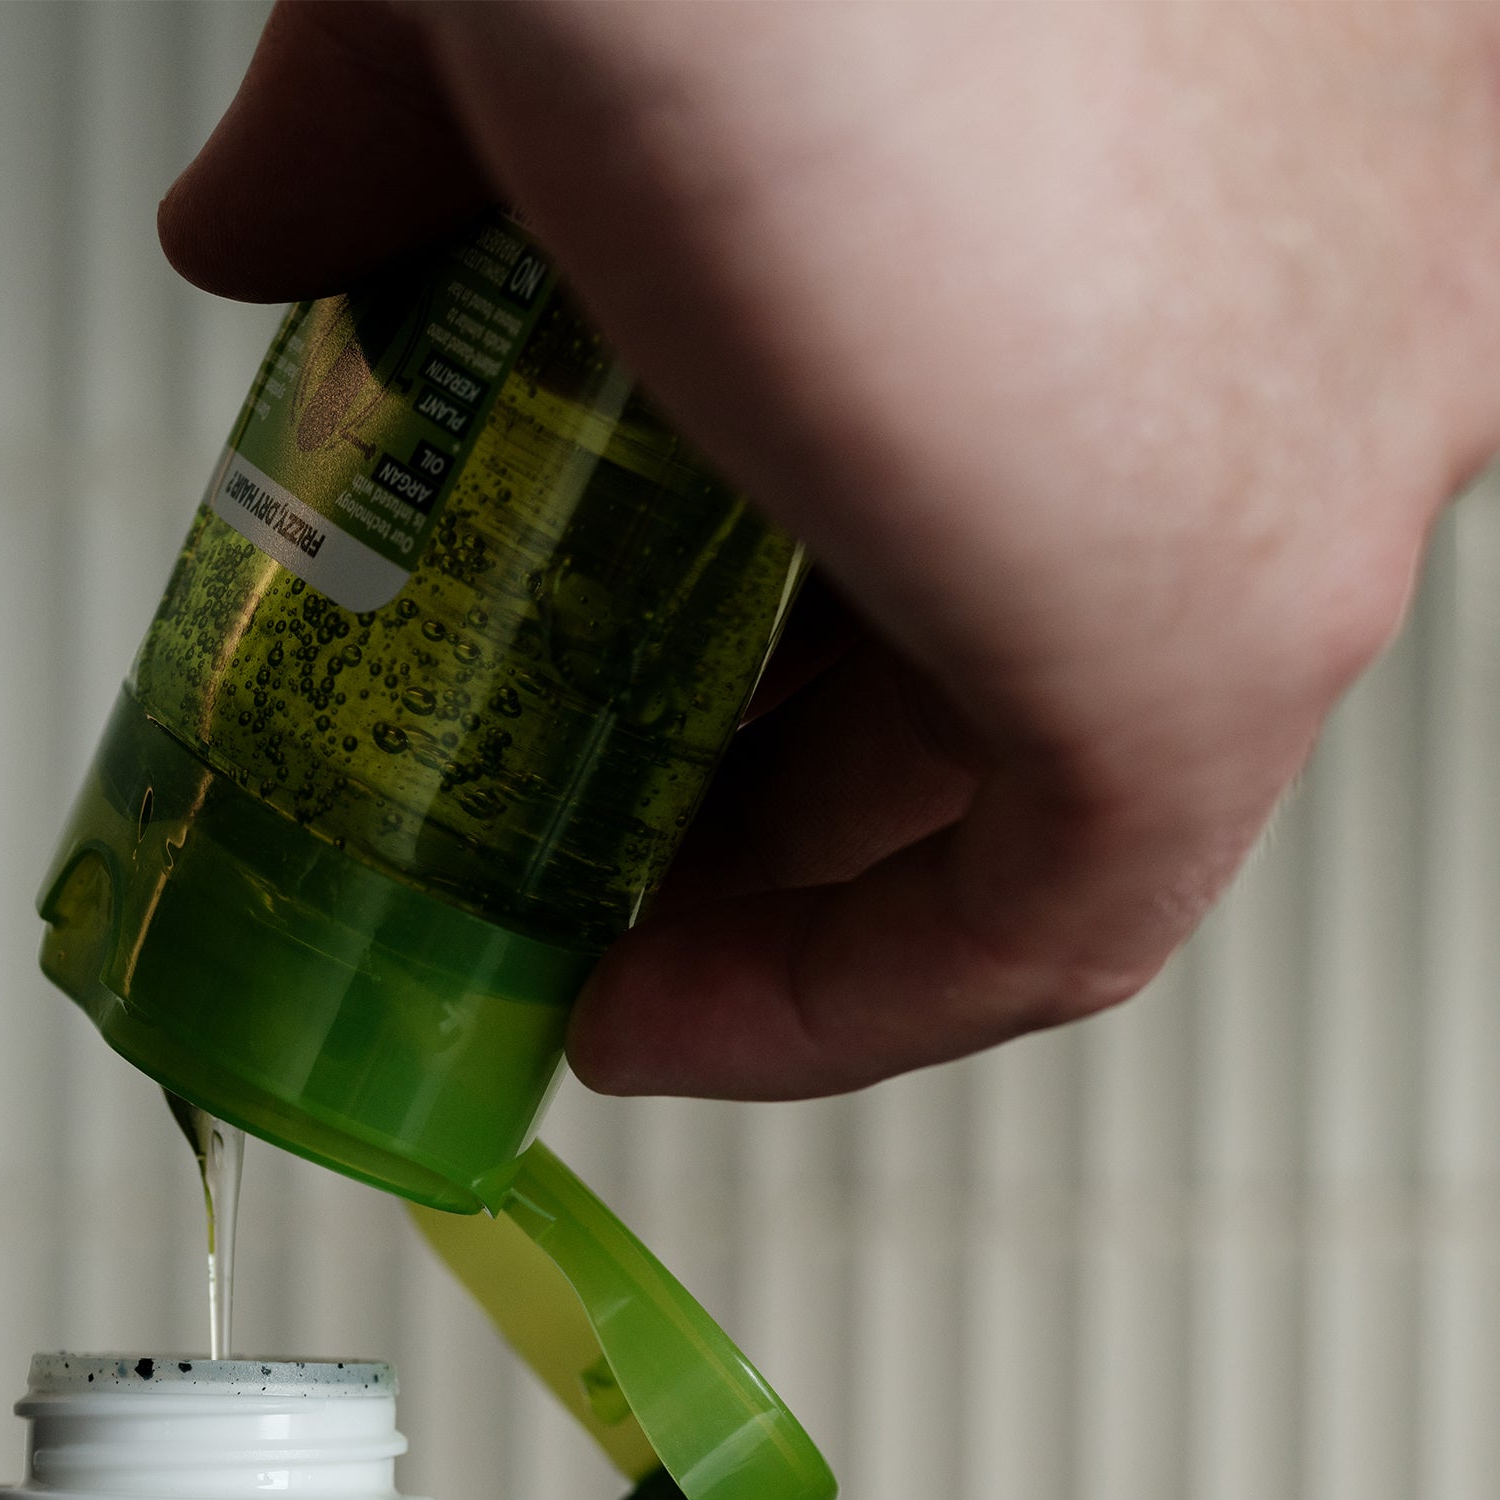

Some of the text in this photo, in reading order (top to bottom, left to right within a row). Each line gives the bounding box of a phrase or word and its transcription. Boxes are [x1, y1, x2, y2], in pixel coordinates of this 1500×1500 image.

[509, 255, 547, 301] NO
[425, 359, 481, 402] KERATIN
[418, 393, 467, 432] PLANT
[378, 461, 433, 503] ARGAN
[420, 448, 445, 475] OIL
[249, 491, 280, 525] DRY
[334, 490, 414, 553] Our technology
[352, 473, 427, 531] is infused with
